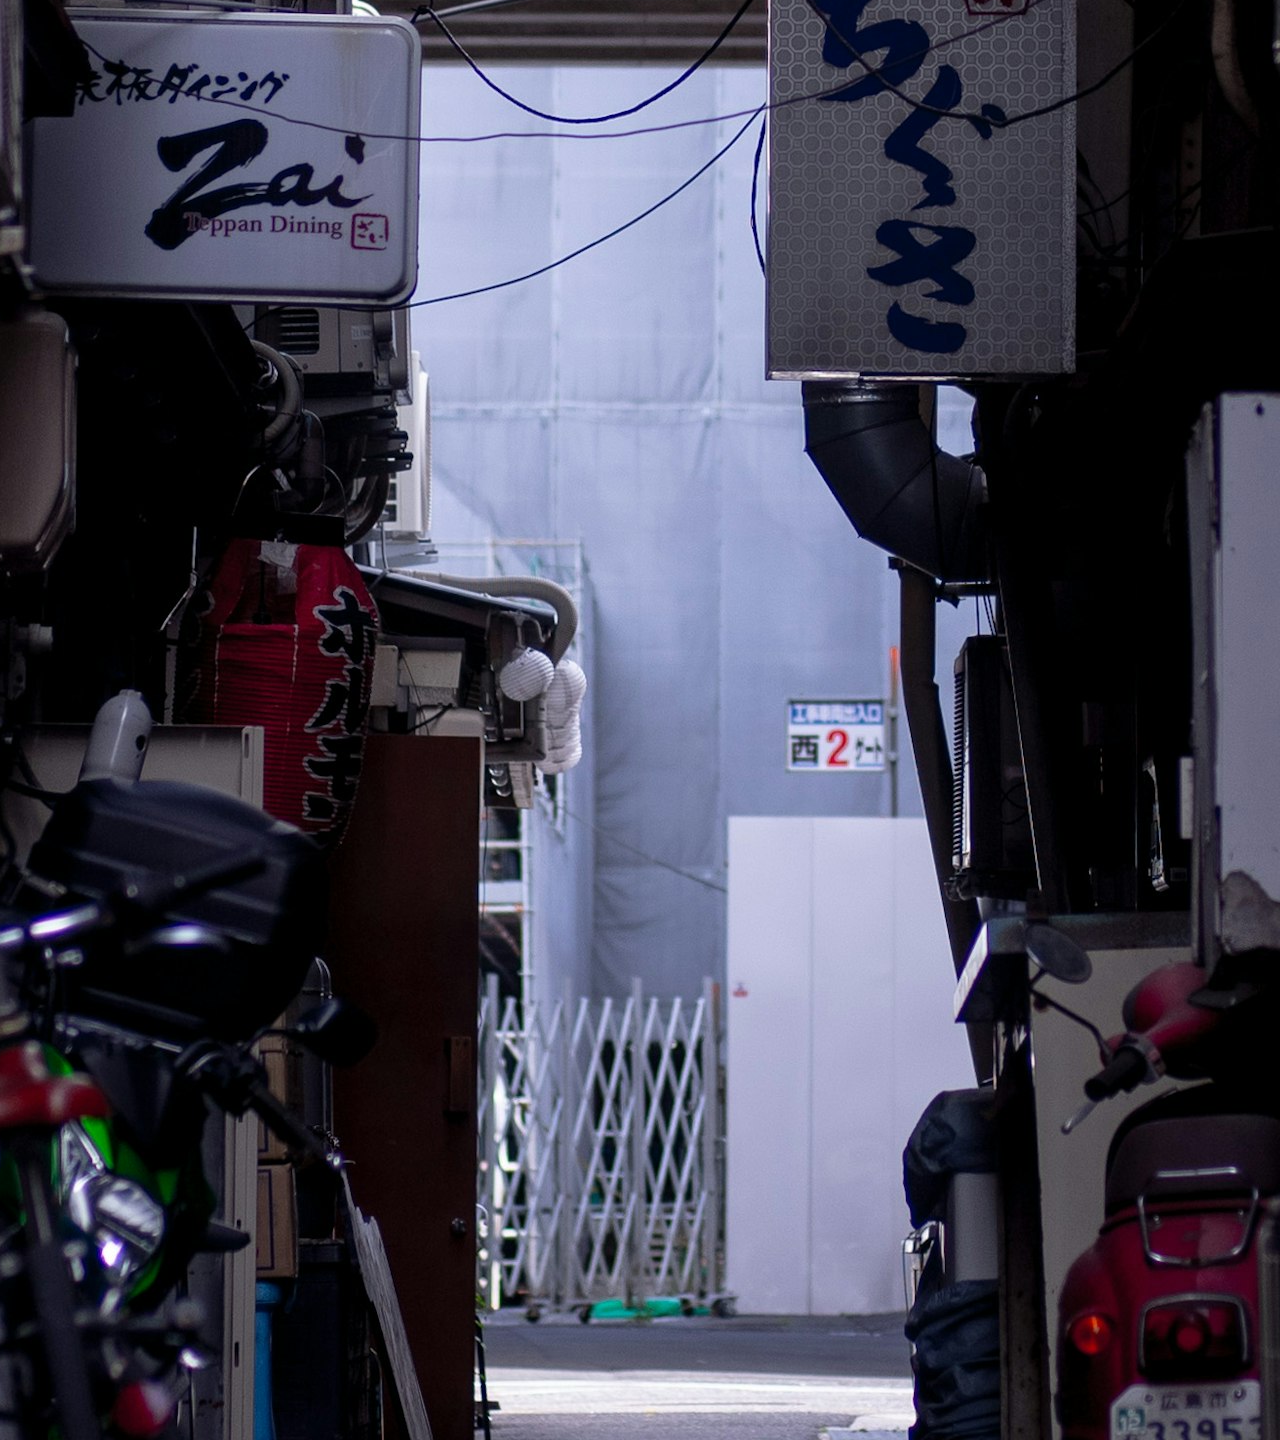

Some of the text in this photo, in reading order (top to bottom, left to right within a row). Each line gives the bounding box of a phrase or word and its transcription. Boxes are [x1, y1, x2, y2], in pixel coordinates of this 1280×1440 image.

[145, 118, 373, 250] Zai
[183, 212, 343, 239] Teppan Dining
[791, 735, 819, 764] 西
[827, 728, 849, 767] 2
